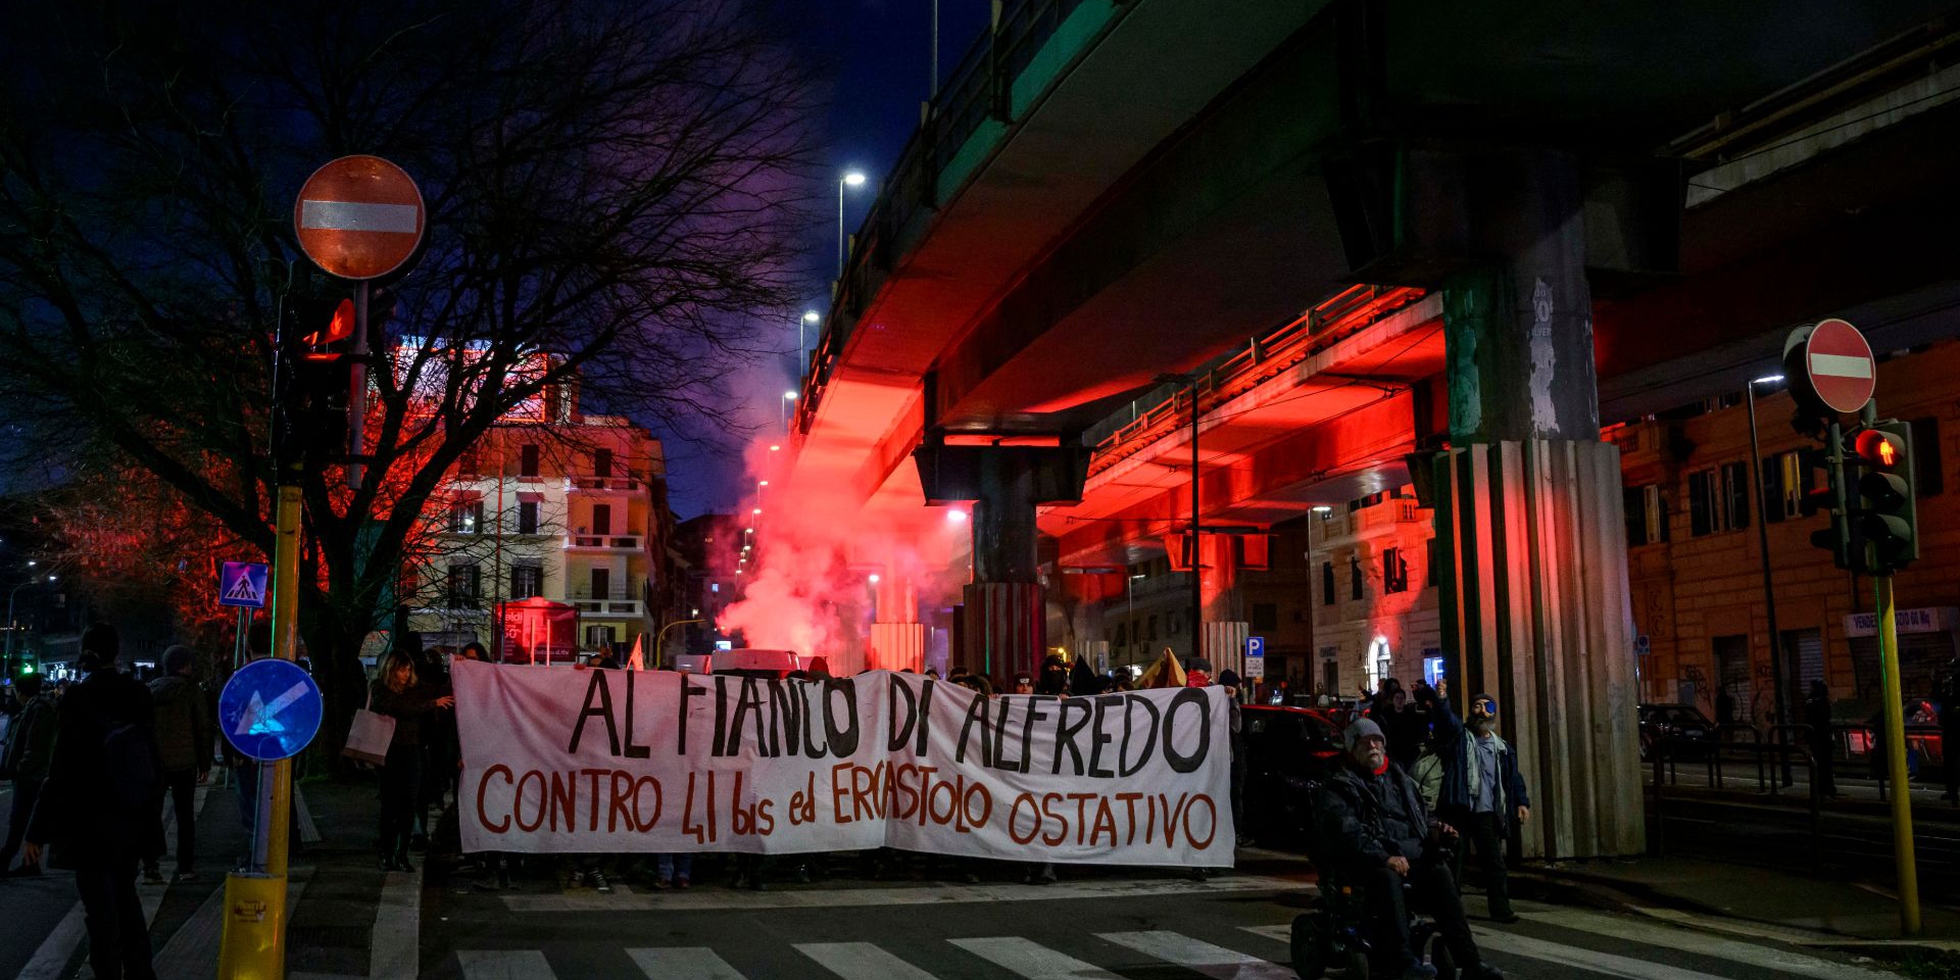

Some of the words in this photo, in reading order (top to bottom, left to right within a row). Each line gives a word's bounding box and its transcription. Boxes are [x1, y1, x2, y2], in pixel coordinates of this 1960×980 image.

[1249, 639, 1260, 655] P
[1853, 614, 1879, 629] VENDES
[568, 668, 650, 758] AL
[678, 672, 859, 759] FIANCO
[888, 672, 935, 757] DI
[956, 686, 1211, 778] ALFREDO
[477, 763, 662, 833] CONTRO
[682, 769, 716, 844] 41
[732, 770, 775, 836] bis
[789, 771, 816, 826] ed
[1008, 792, 1217, 850] OSTATIVO
